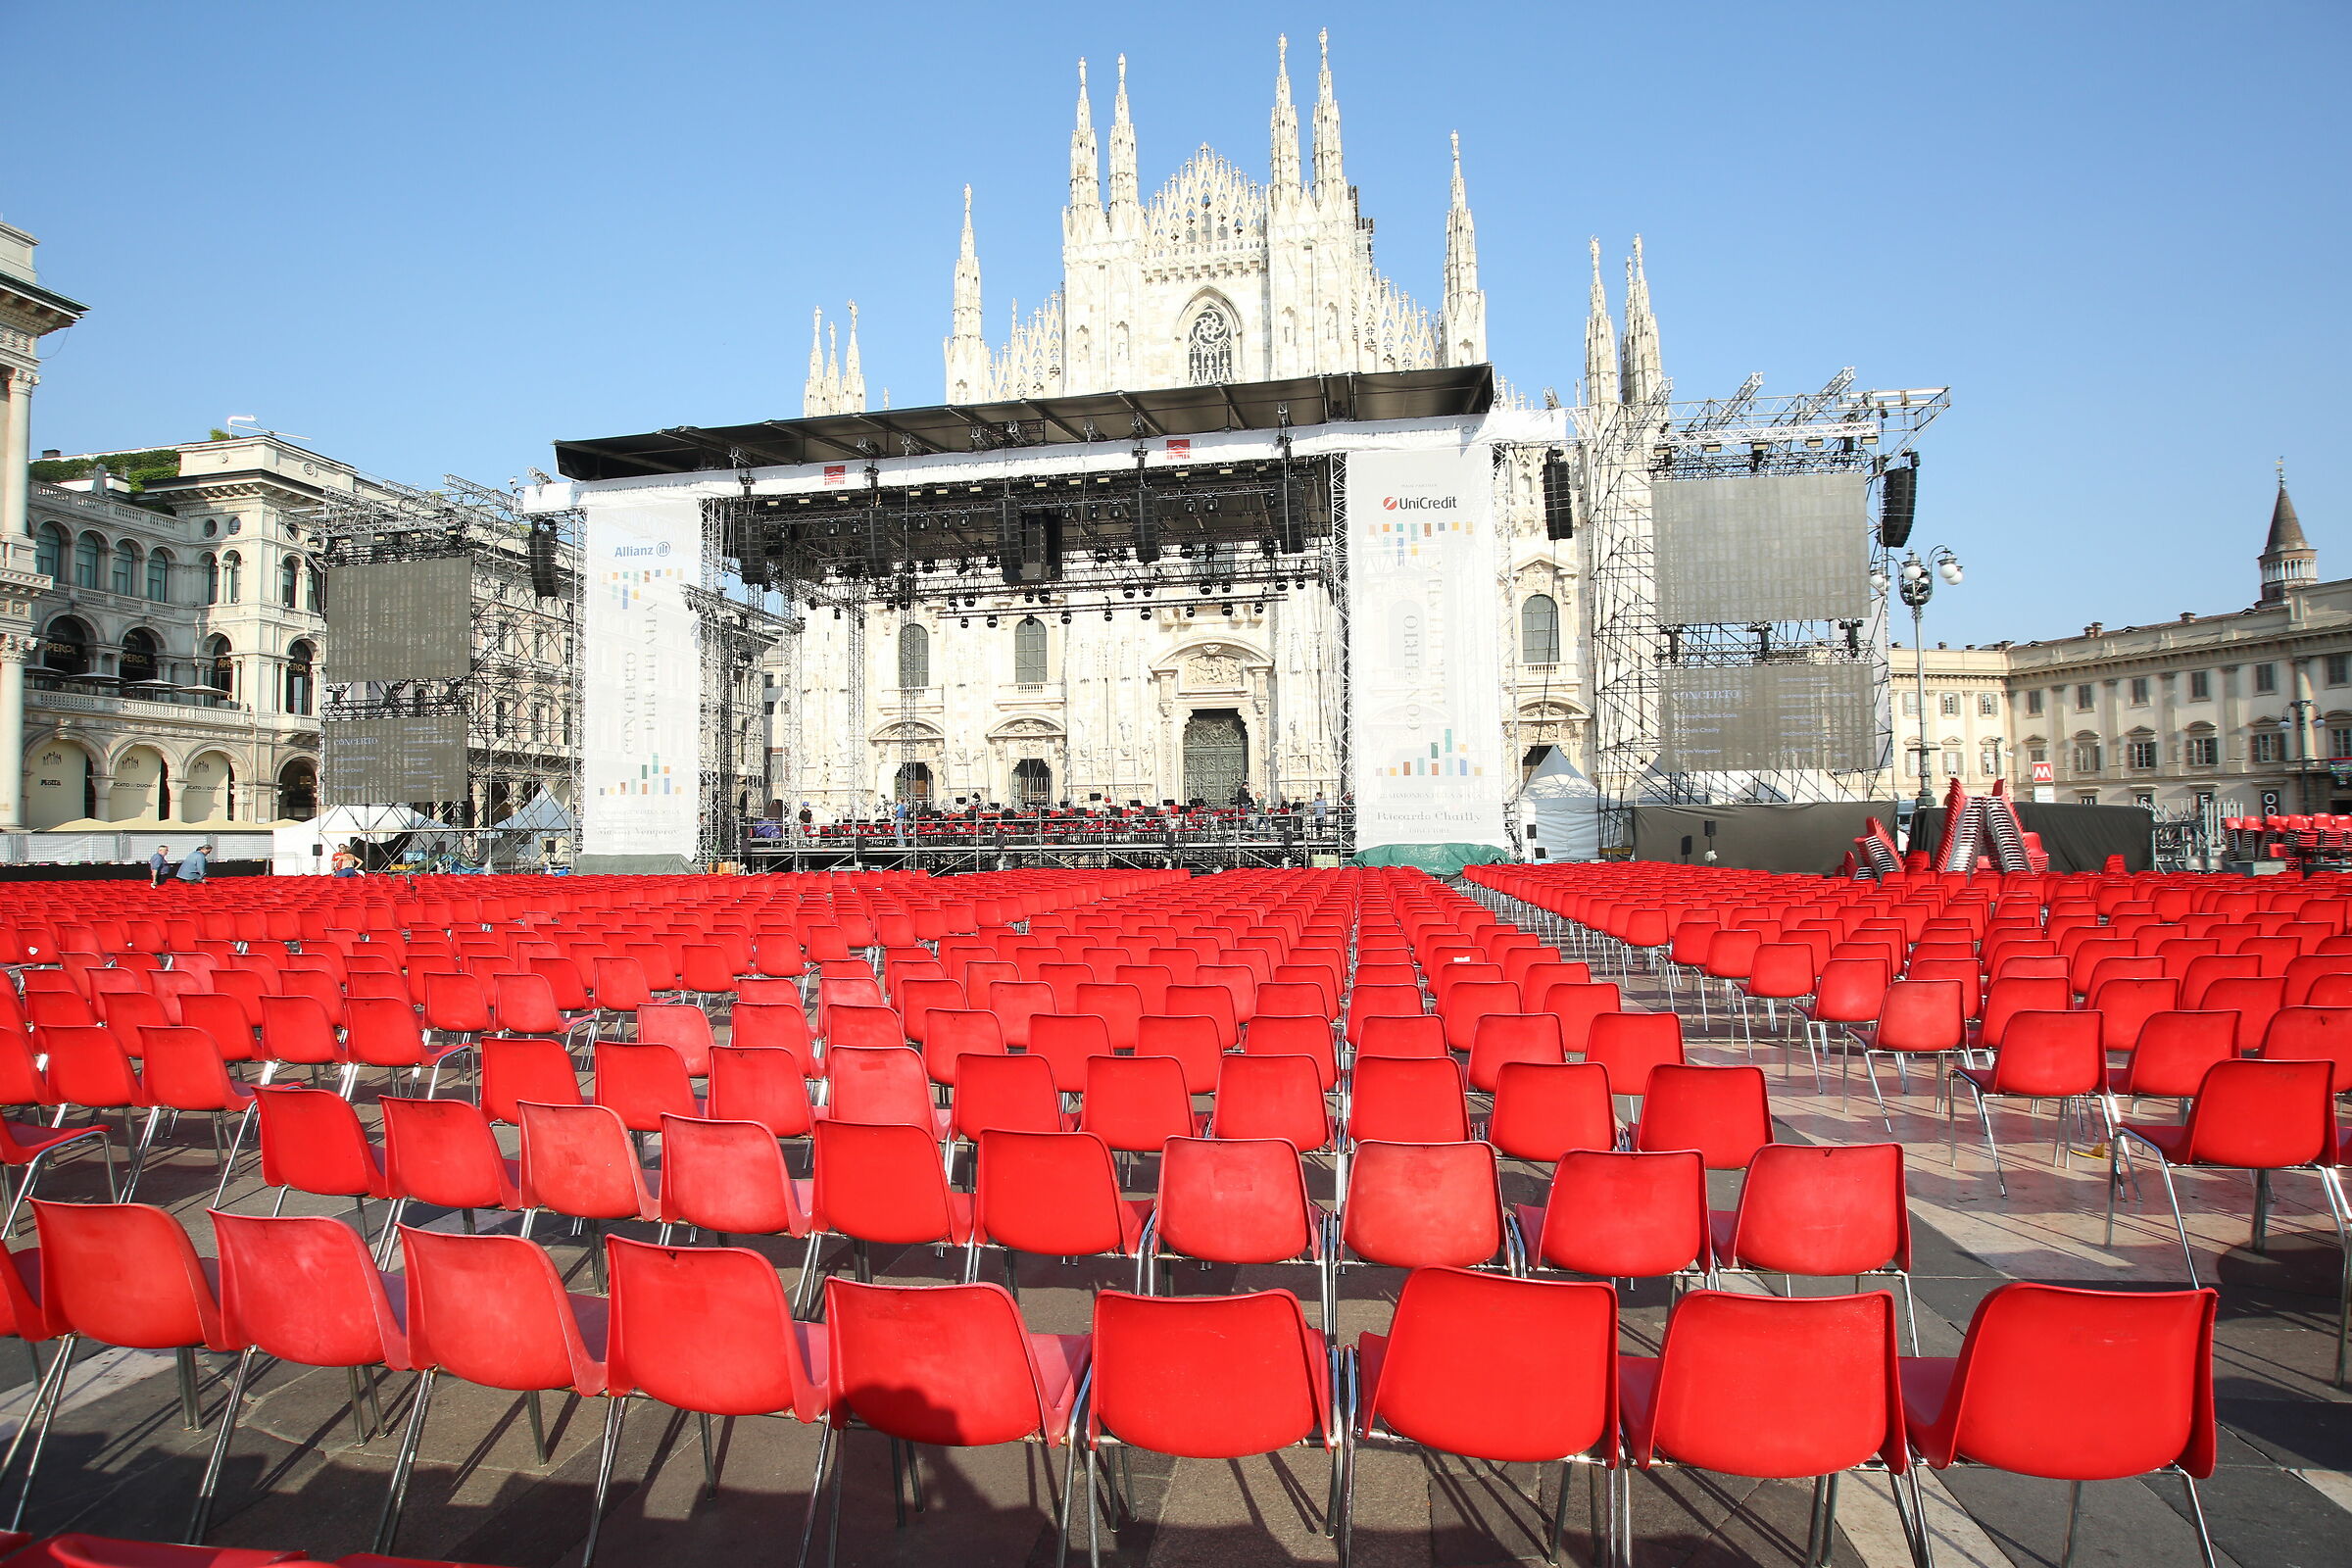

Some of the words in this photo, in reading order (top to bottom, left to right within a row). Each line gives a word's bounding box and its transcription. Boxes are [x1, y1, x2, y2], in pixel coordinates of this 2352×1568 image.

[1399, 496, 1457, 510] UniCredit
[614, 545, 654, 558] Allianz
[122, 653, 149, 663] PEROL
[1404, 614, 1421, 731] CONCERTO
[1672, 689, 1741, 700] CONCERTO
[623, 651, 636, 755] CONCERTO
[334, 737, 378, 746] CONCERTO
[1435, 810, 1482, 824] Chailly
